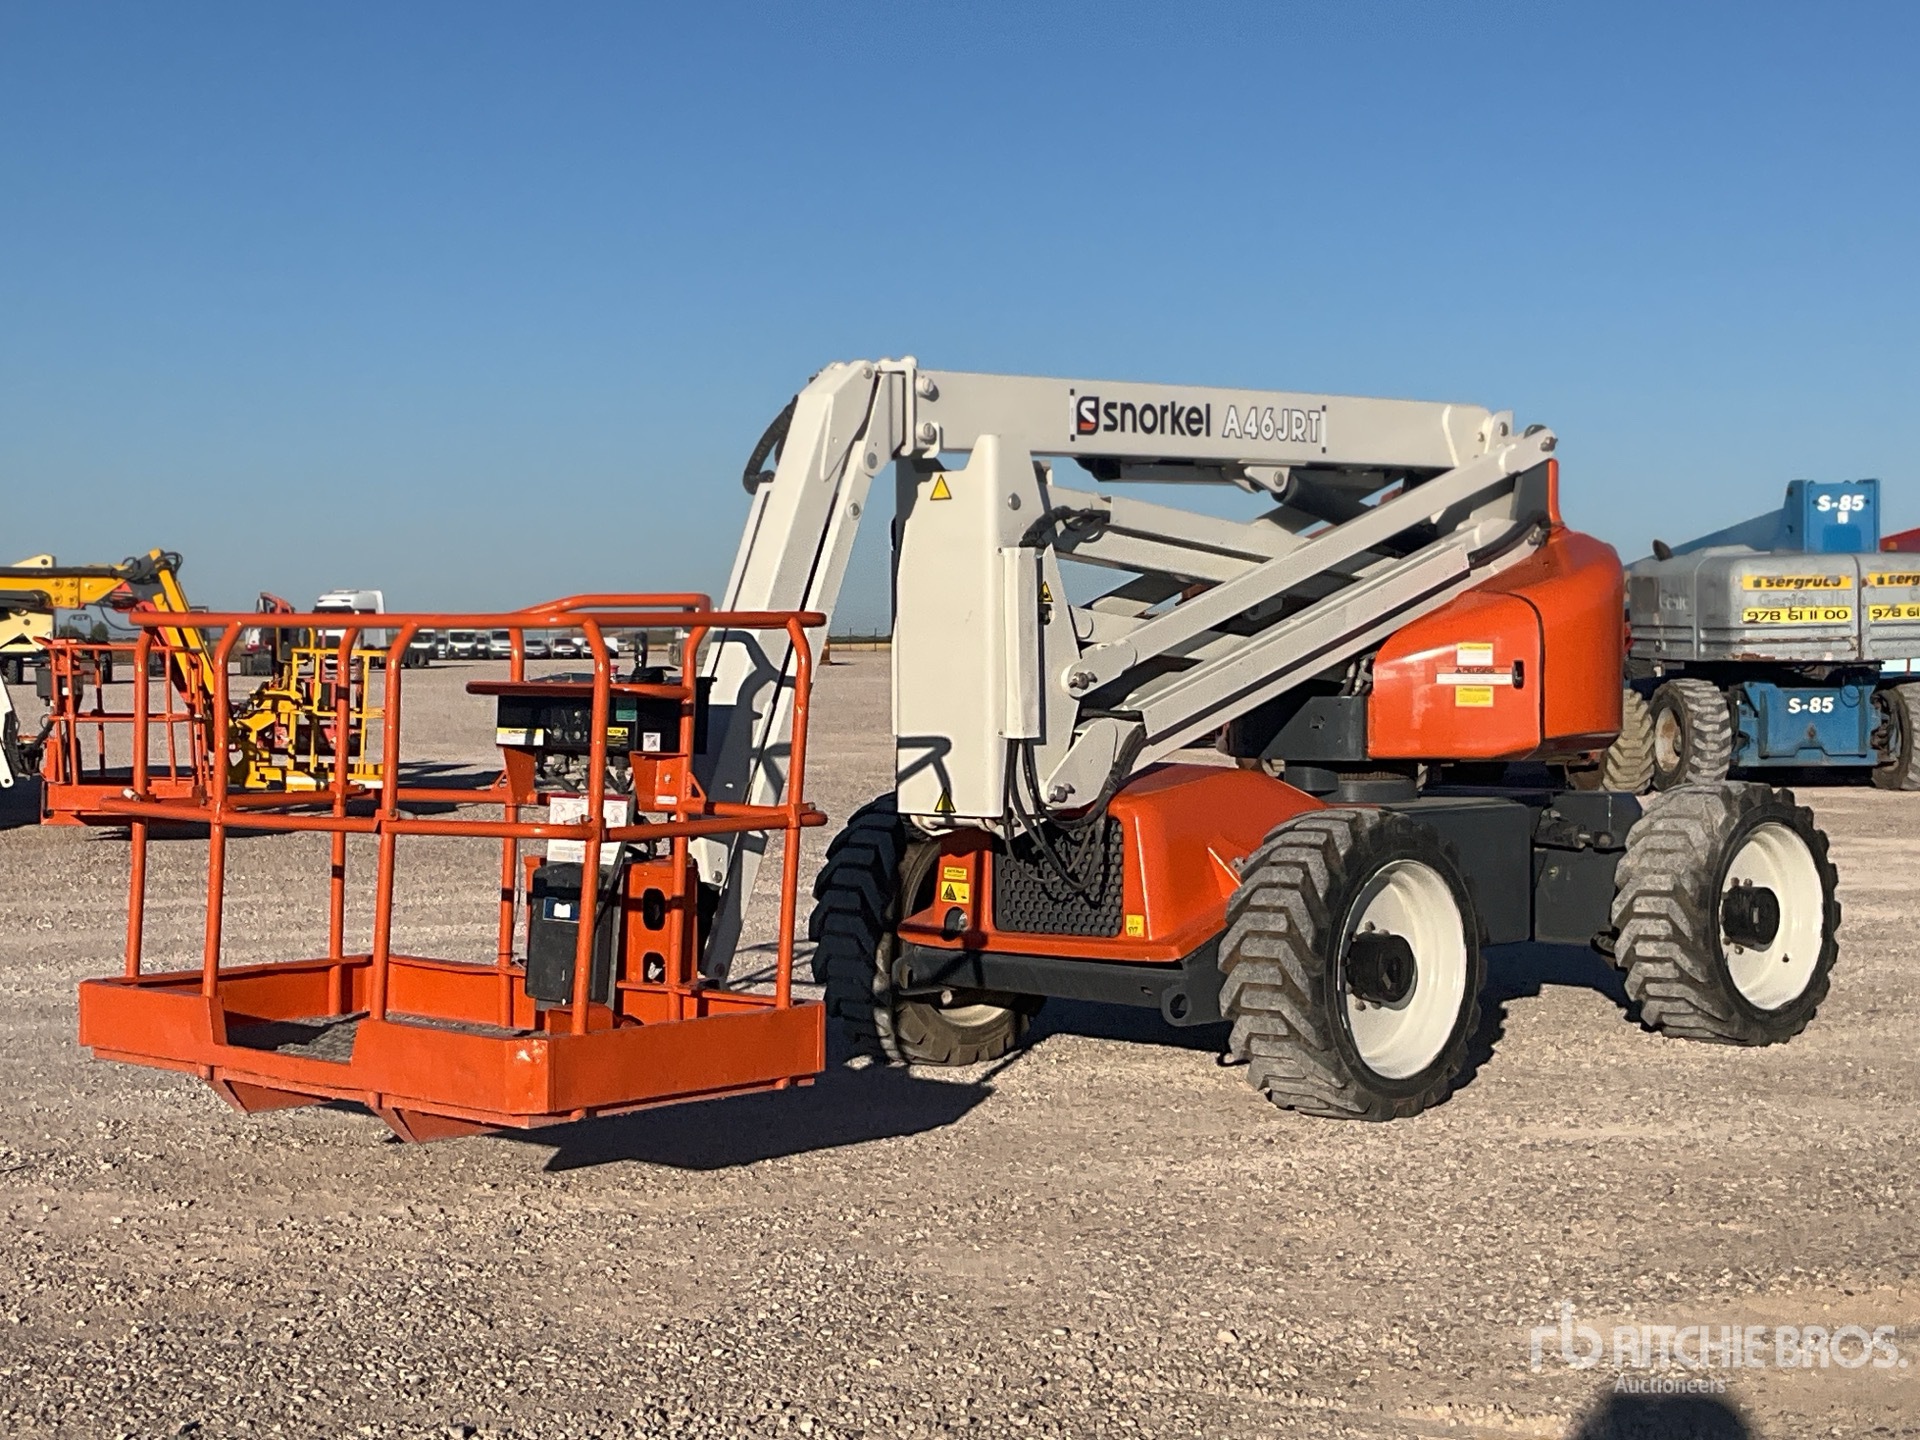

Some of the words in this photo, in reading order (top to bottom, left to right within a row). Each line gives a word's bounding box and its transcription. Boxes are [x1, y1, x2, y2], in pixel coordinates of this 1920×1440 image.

[1102, 401, 1211, 437] snorkel
[1222, 404, 1321, 443] A46JRT
[1816, 494, 1865, 512] S-85
[1747, 610, 1781, 621] 978
[1788, 610, 1803, 620] 61
[1824, 609, 1848, 620] 00
[1872, 607, 1902, 619] 978
[1787, 696, 1835, 714] S-85
